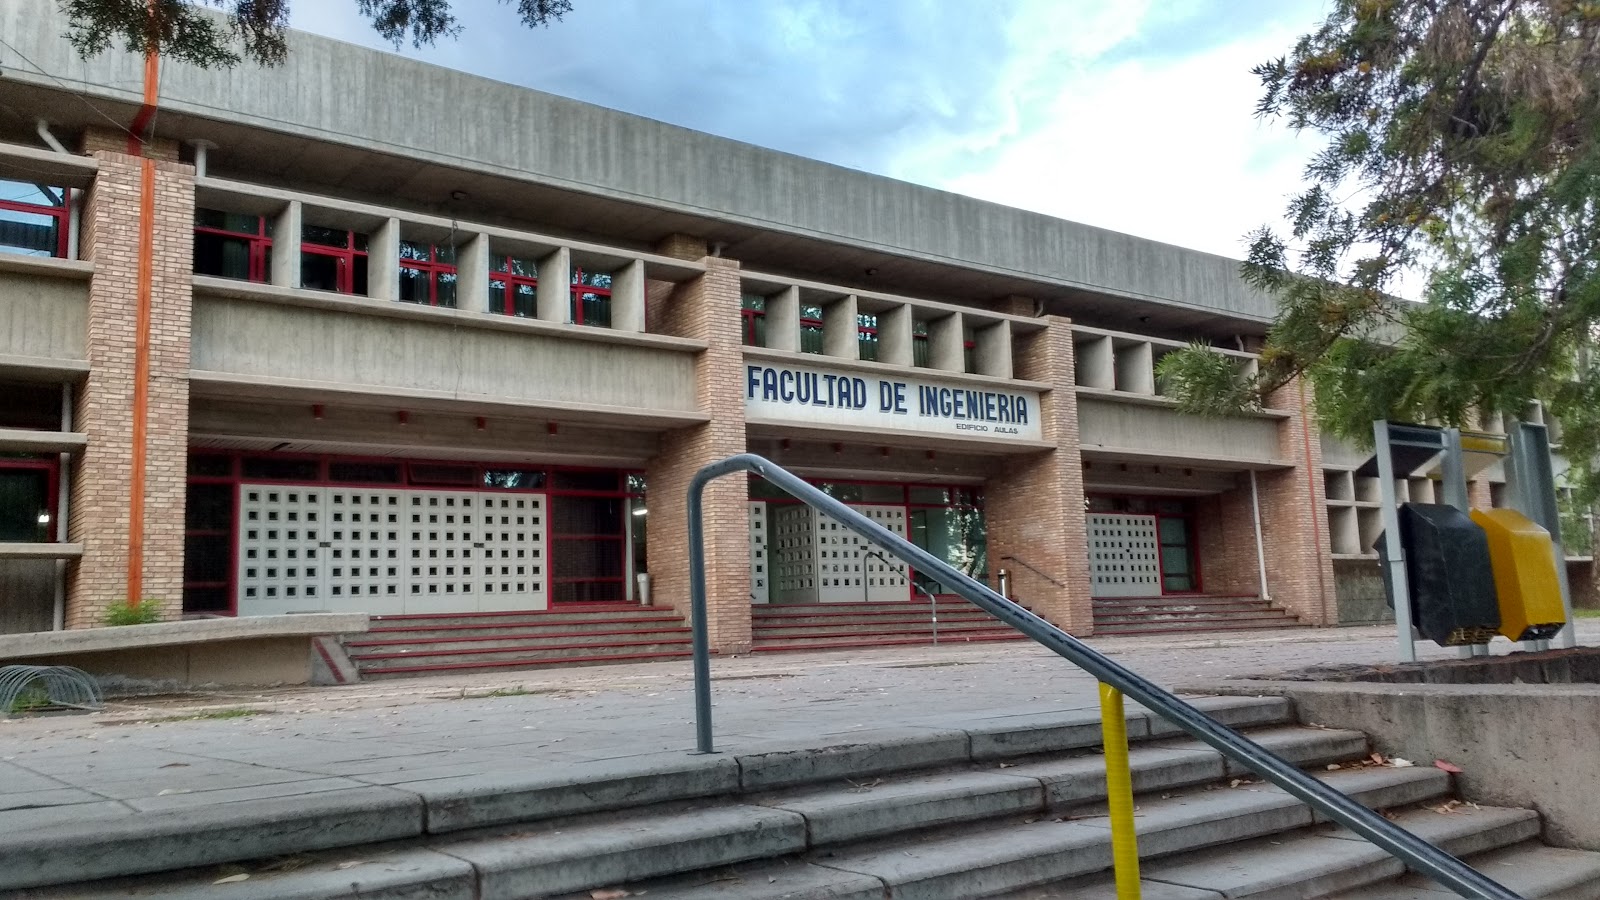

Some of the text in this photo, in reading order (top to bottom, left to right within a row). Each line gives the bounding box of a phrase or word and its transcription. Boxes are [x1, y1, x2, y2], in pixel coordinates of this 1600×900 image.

[748, 365, 1029, 425] FACULTAD DE INGENIERIA
[956, 423, 1019, 435] EDIFICIO AULAS
